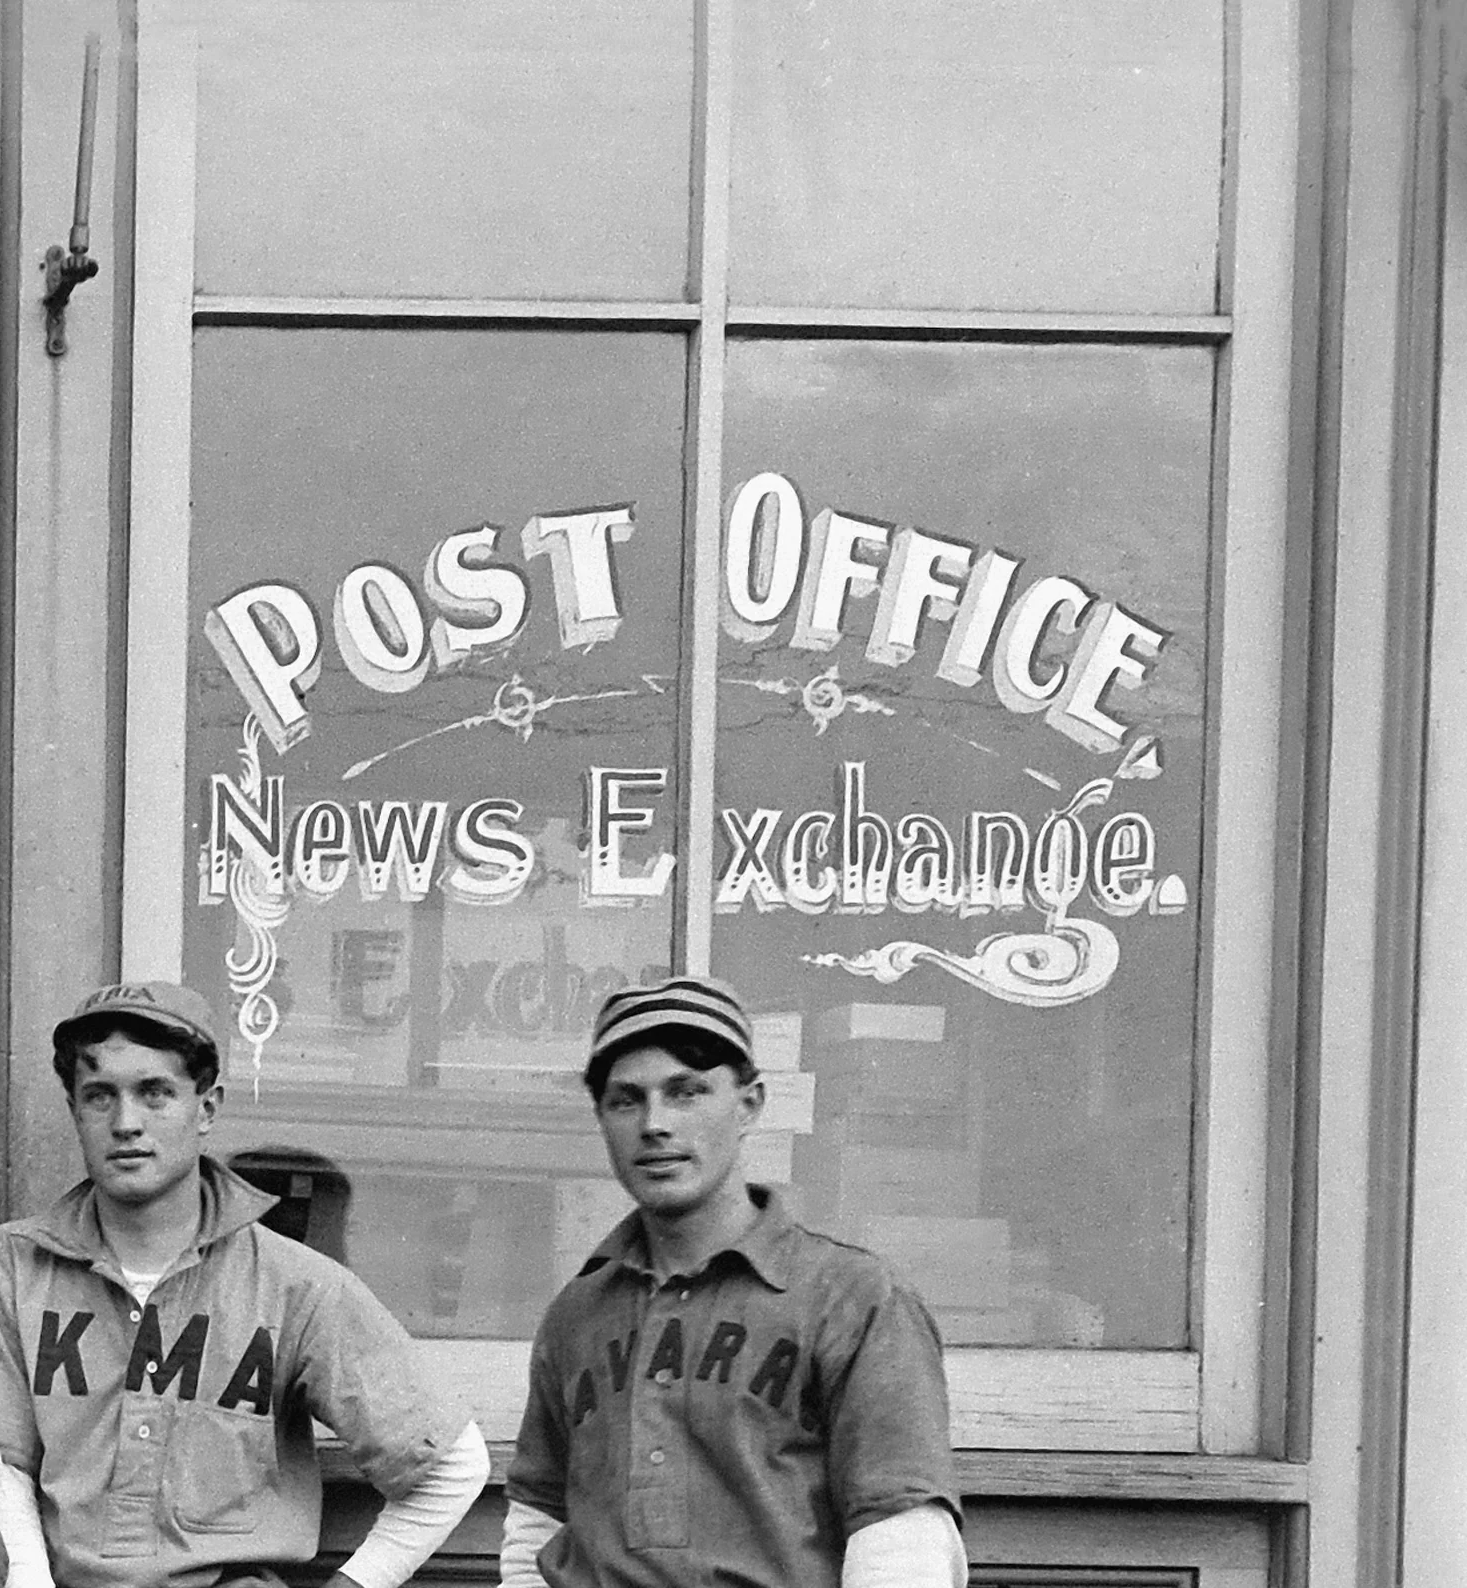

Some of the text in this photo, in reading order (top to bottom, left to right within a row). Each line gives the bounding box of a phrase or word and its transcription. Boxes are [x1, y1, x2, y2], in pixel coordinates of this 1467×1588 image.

[204, 500, 637, 757] POST
[199, 773, 537, 906] News
[33, 1303, 274, 1416] KMA
